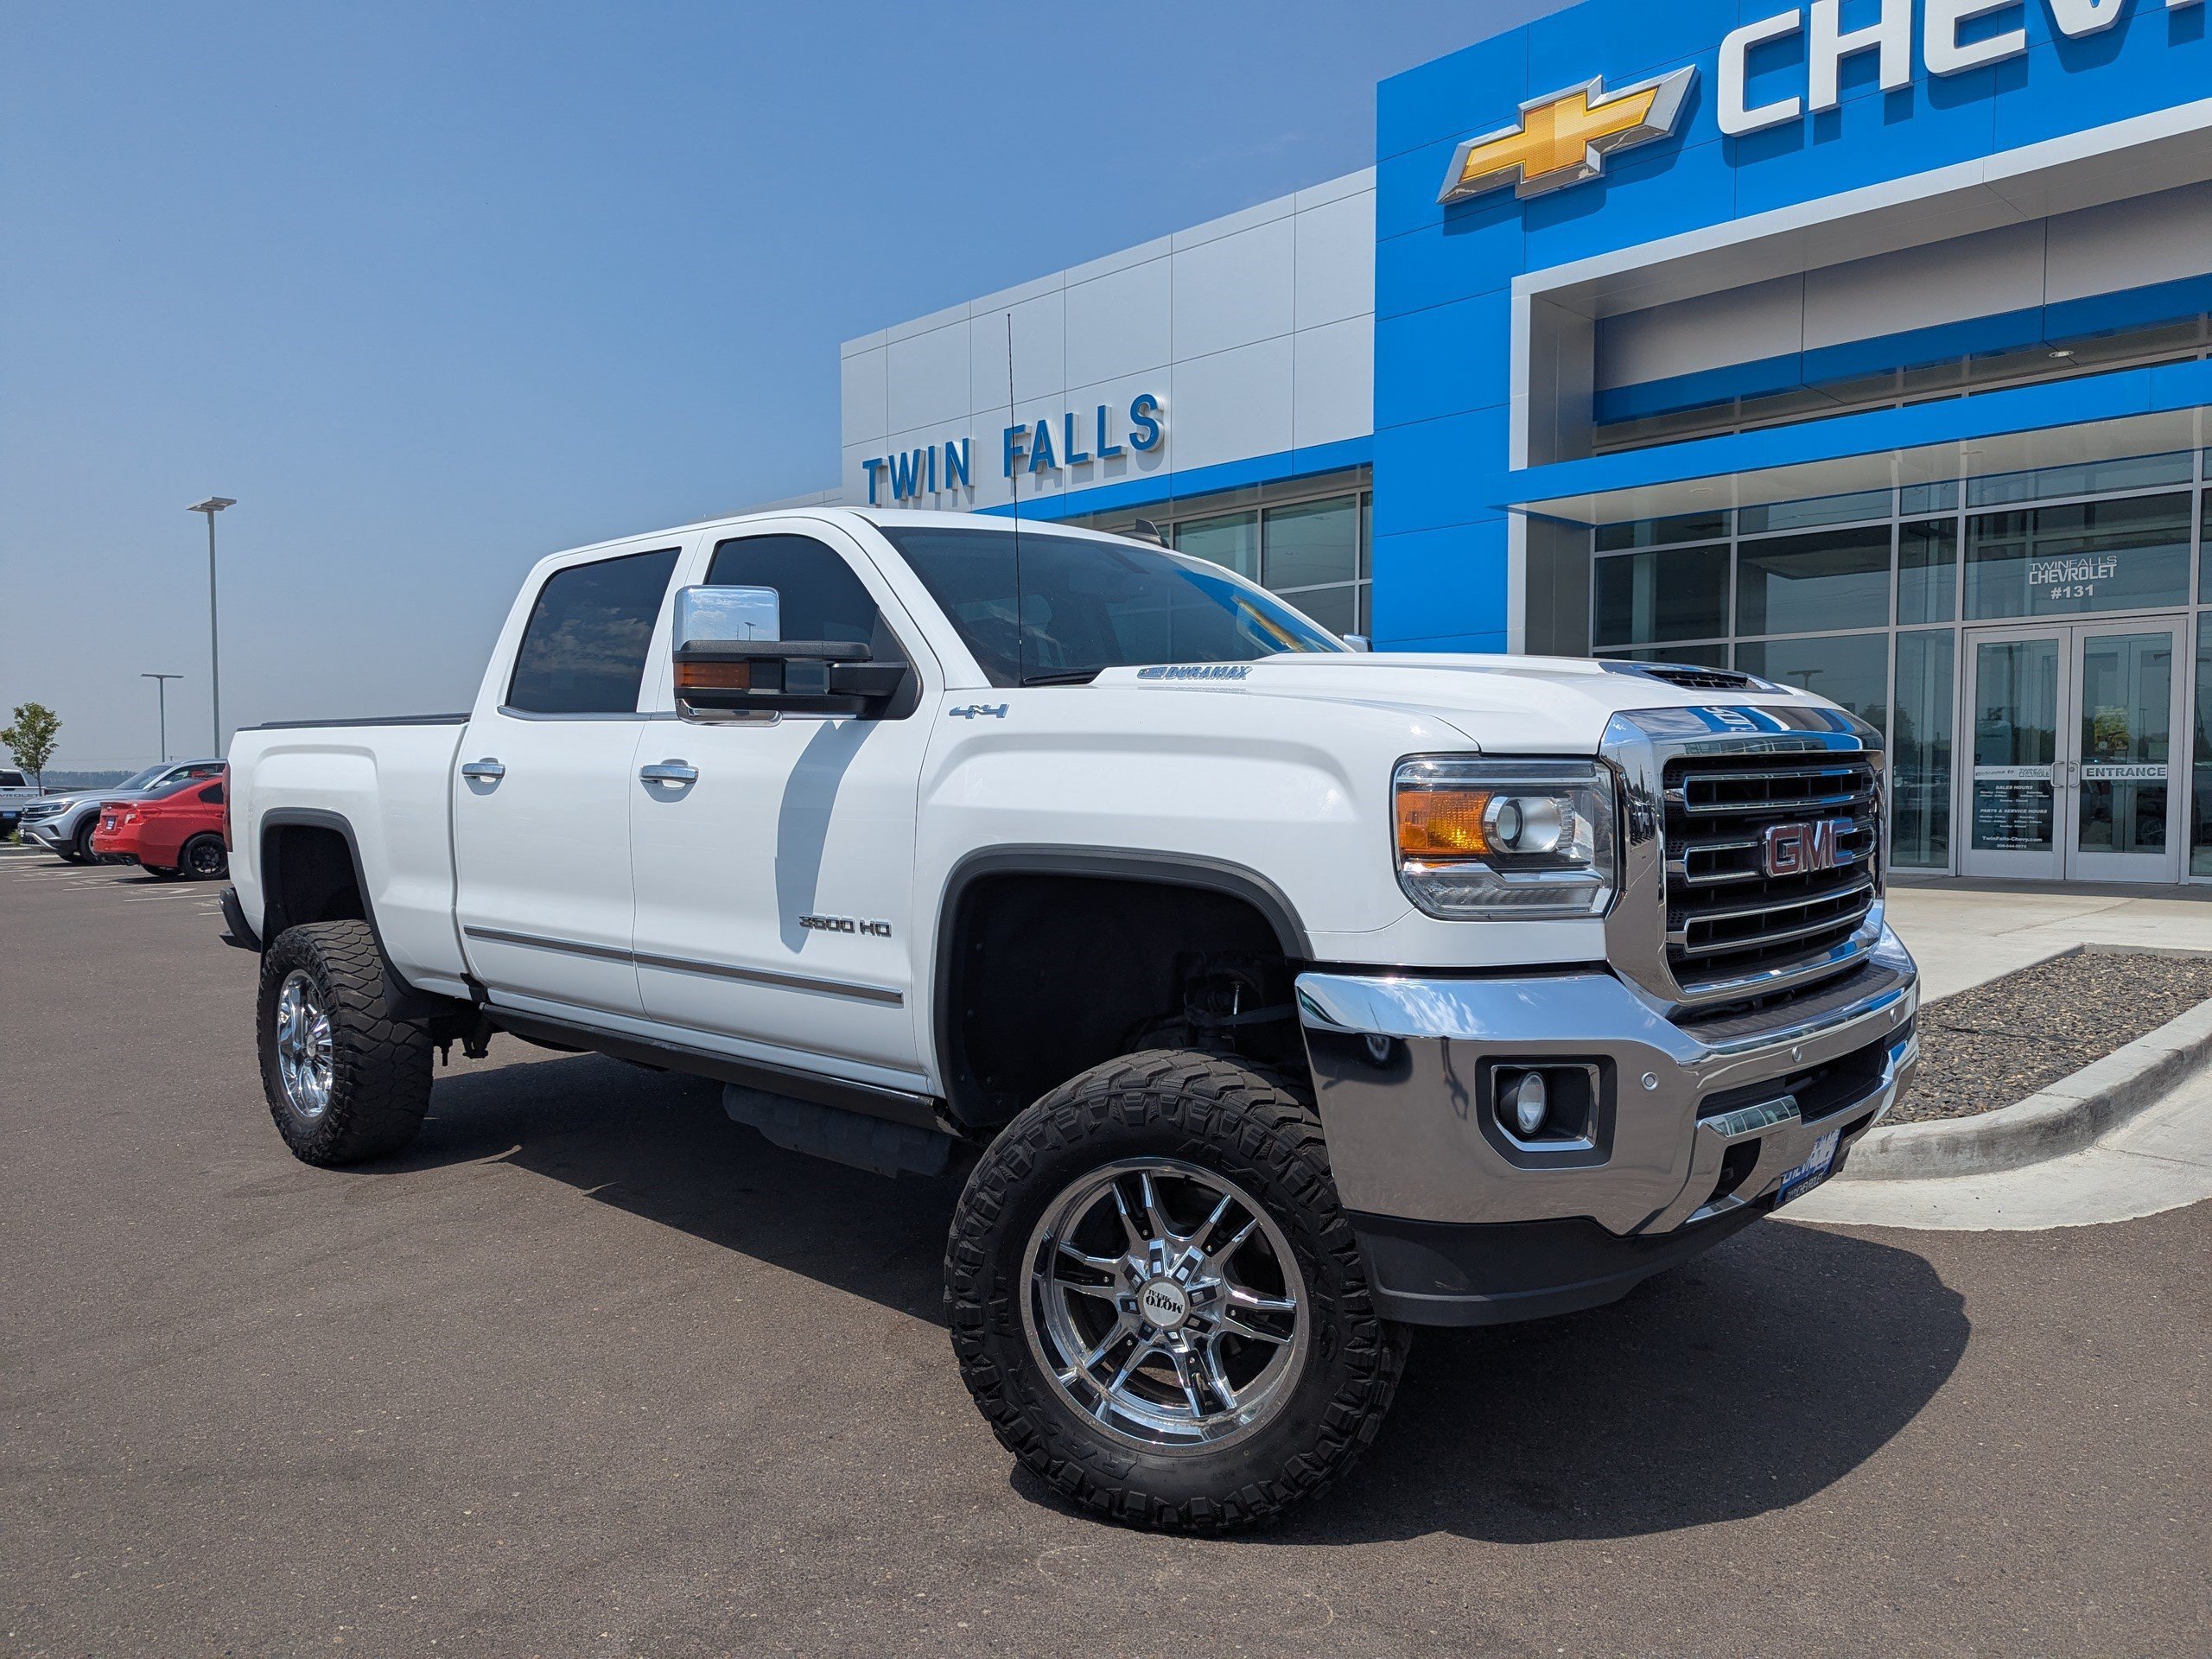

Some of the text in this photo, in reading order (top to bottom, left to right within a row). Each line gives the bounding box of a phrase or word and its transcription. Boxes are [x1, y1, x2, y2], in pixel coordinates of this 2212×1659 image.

[862, 393, 1165, 505] TWIN FALLS
[2029, 564, 2117, 585] CHEVROLET
[2050, 584, 2094, 600] #131
[1166, 665, 1253, 681] DURAMAX
[2086, 767, 2166, 777] ENTRANCE
[1765, 817, 1854, 878] GMC
[1145, 1294, 1184, 1314] MOTO
